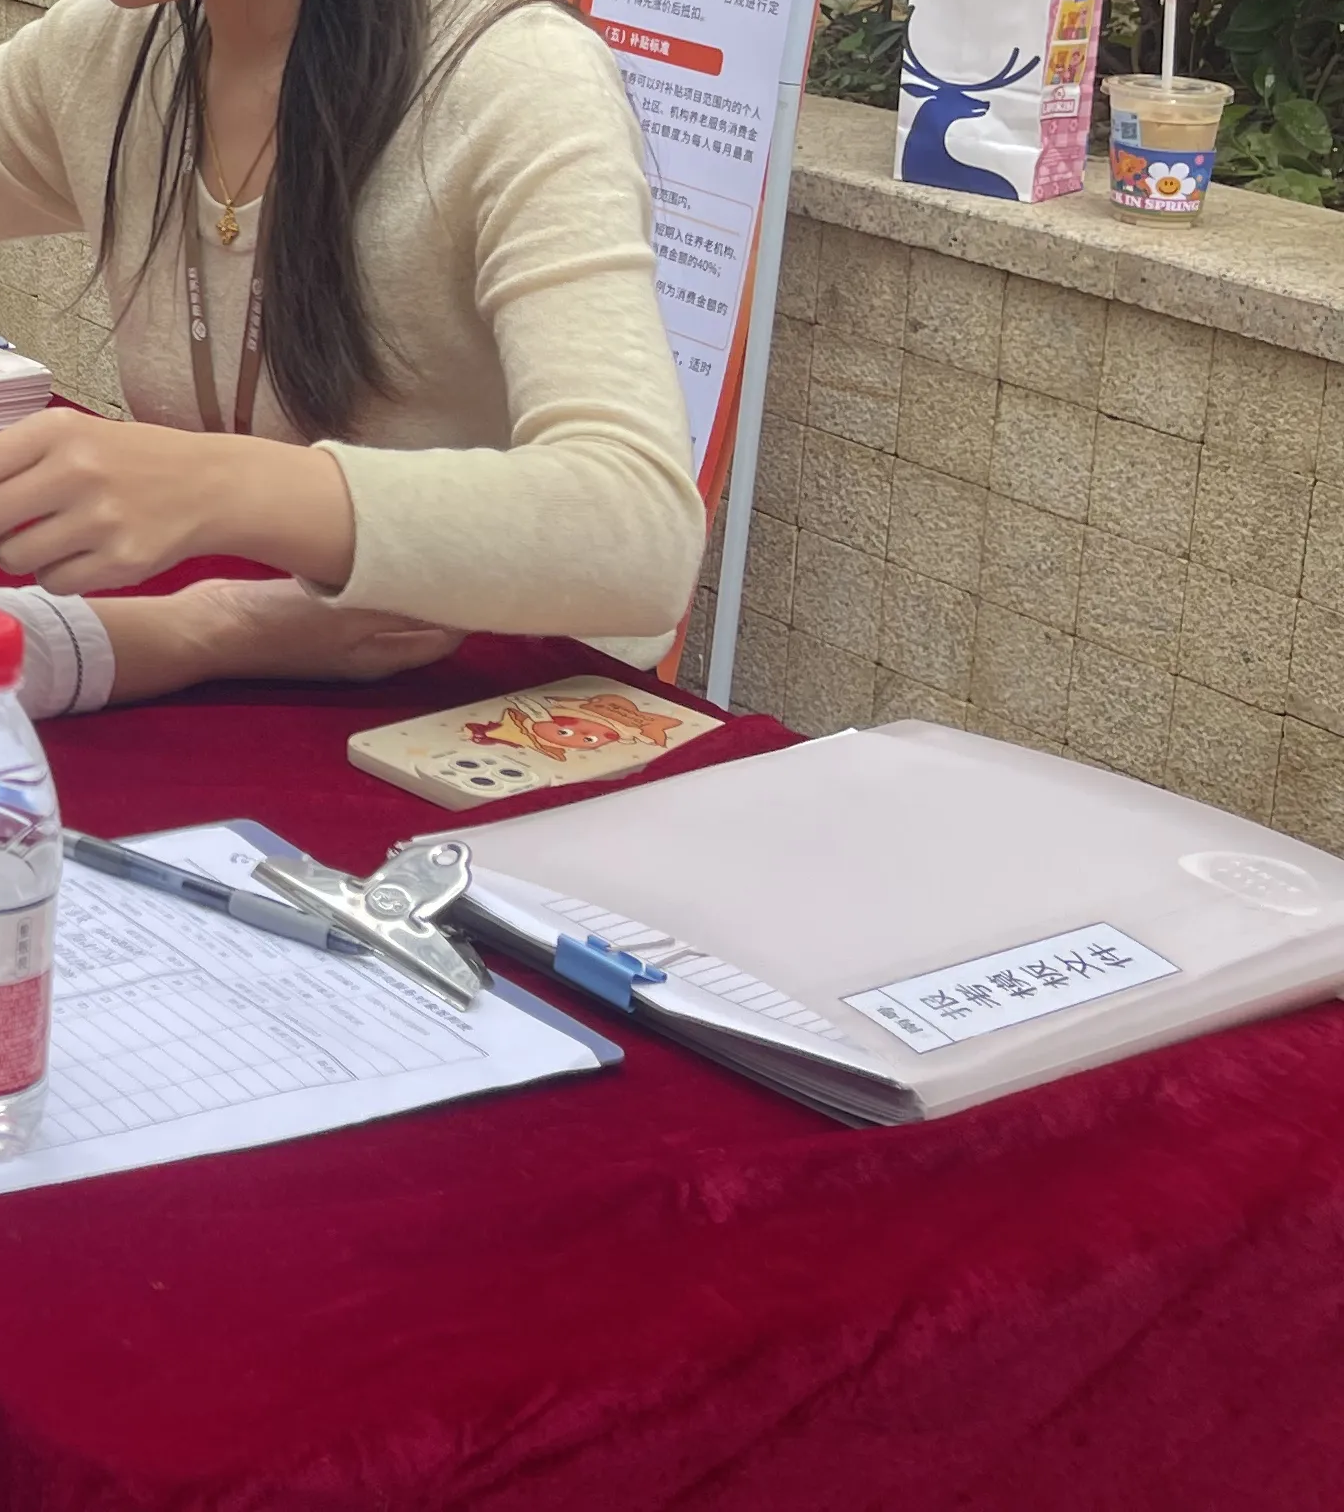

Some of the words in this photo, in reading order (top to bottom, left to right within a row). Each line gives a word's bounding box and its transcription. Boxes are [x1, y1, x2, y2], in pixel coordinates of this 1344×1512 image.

[1144, 198, 1201, 212] SPRING
[918, 942, 1137, 1022] 报考模板文件
